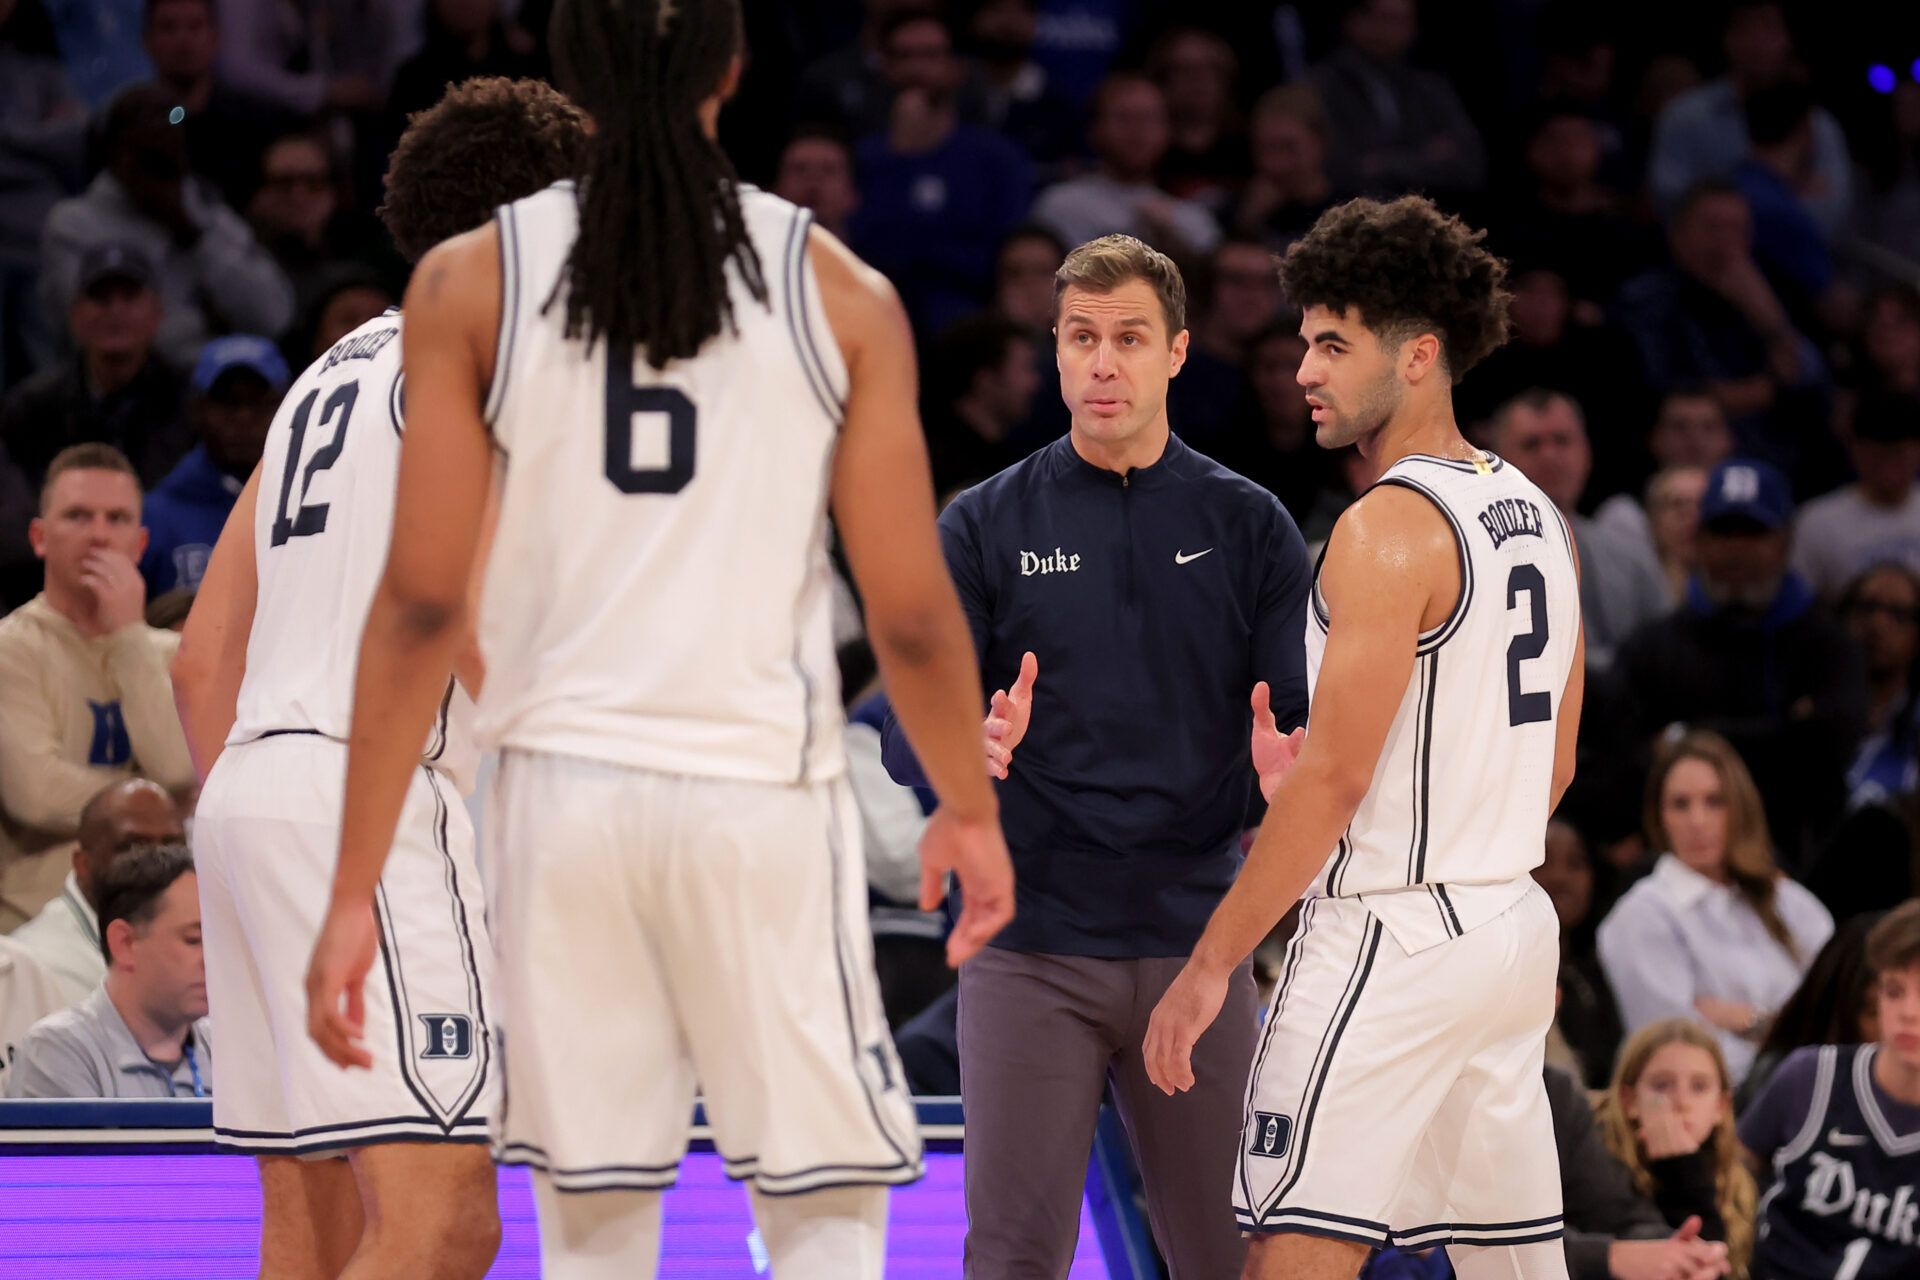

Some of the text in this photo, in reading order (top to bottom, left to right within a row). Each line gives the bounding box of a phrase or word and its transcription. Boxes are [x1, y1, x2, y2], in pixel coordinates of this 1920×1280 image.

[270, 379, 360, 548] 12
[606, 336, 696, 494] 6
[1019, 546, 1081, 577] Duke
[1506, 563, 1552, 727] 2
[1799, 1150, 1920, 1247] Duk
